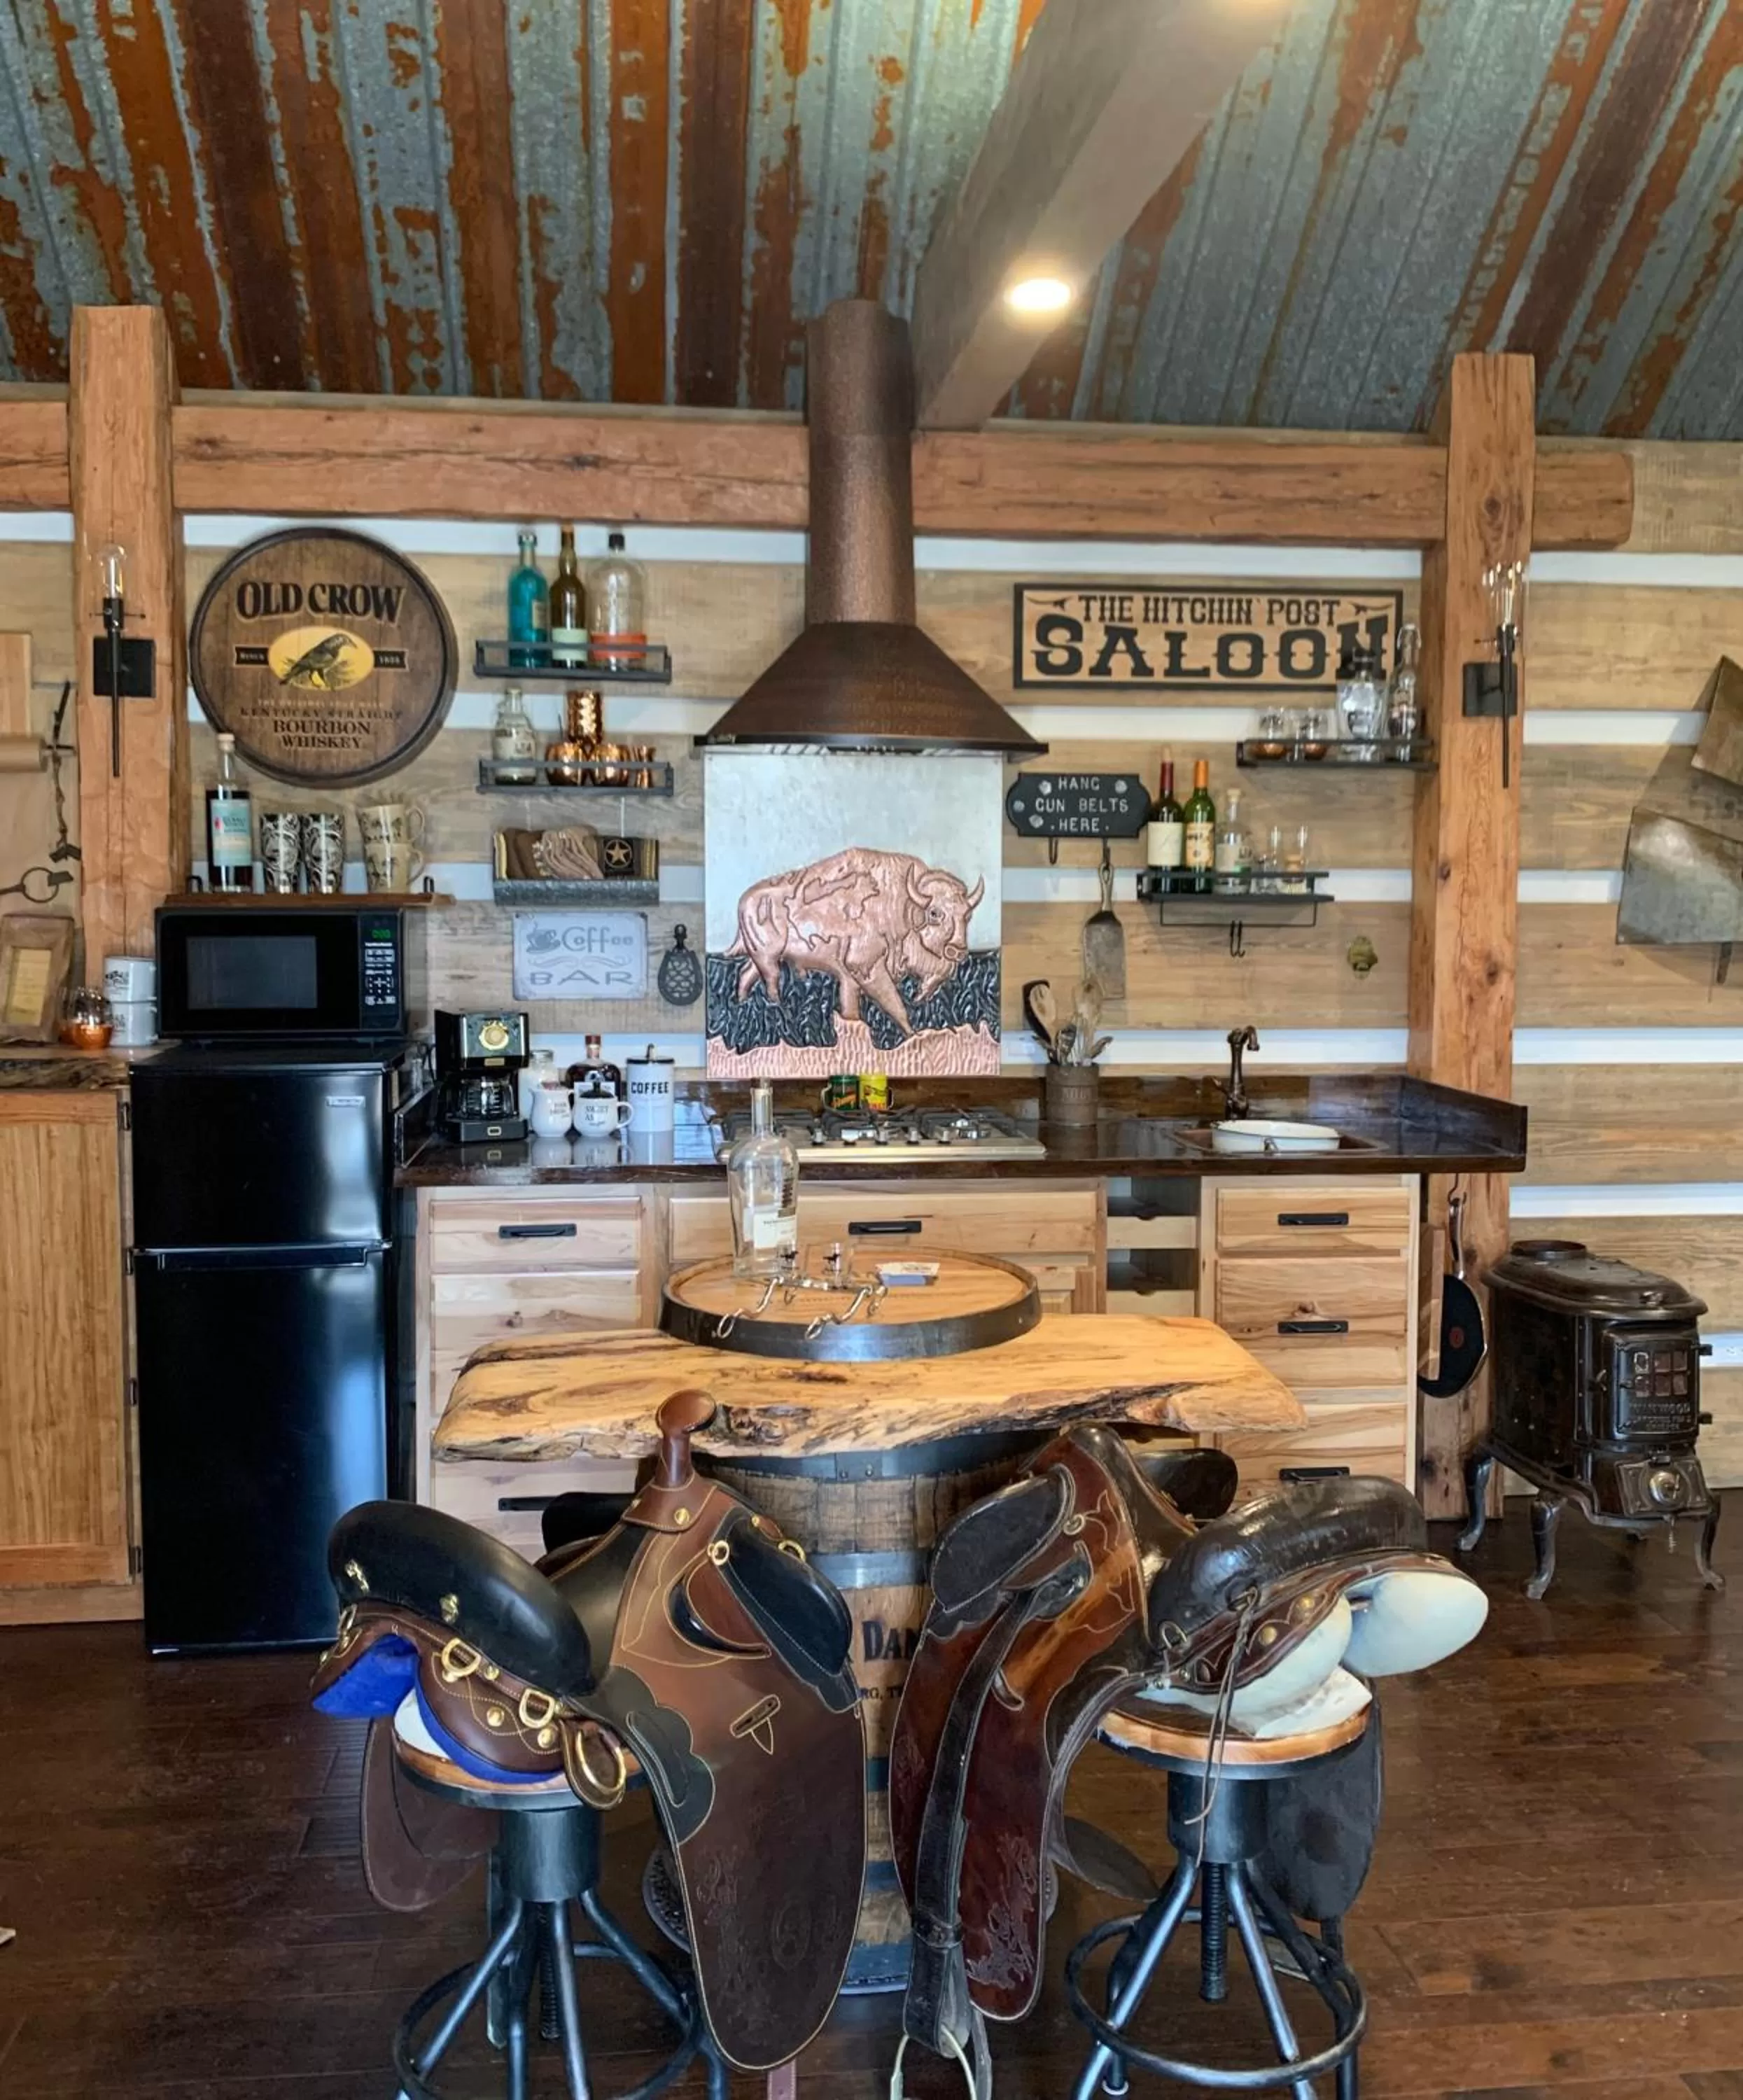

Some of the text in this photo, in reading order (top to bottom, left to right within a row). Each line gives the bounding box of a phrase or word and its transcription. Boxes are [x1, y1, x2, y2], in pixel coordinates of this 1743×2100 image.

[237, 581, 405, 623] OLD CROW
[1078, 595, 1134, 622] THE
[1267, 598, 1340, 626] POST
[1030, 613, 1389, 679] SALOON
[240, 707, 319, 718] KENTUCKY
[274, 720, 370, 734] BOURBON
[281, 735, 361, 749] WHISKEY
[1058, 776, 1100, 790] HANG
[1035, 797, 1128, 813] GUN BELTS
[1058, 817, 1100, 833] HERE
[561, 926, 634, 953] Coffee
[530, 969, 634, 986] BAR
[631, 1082, 669, 1095] COFFEE
